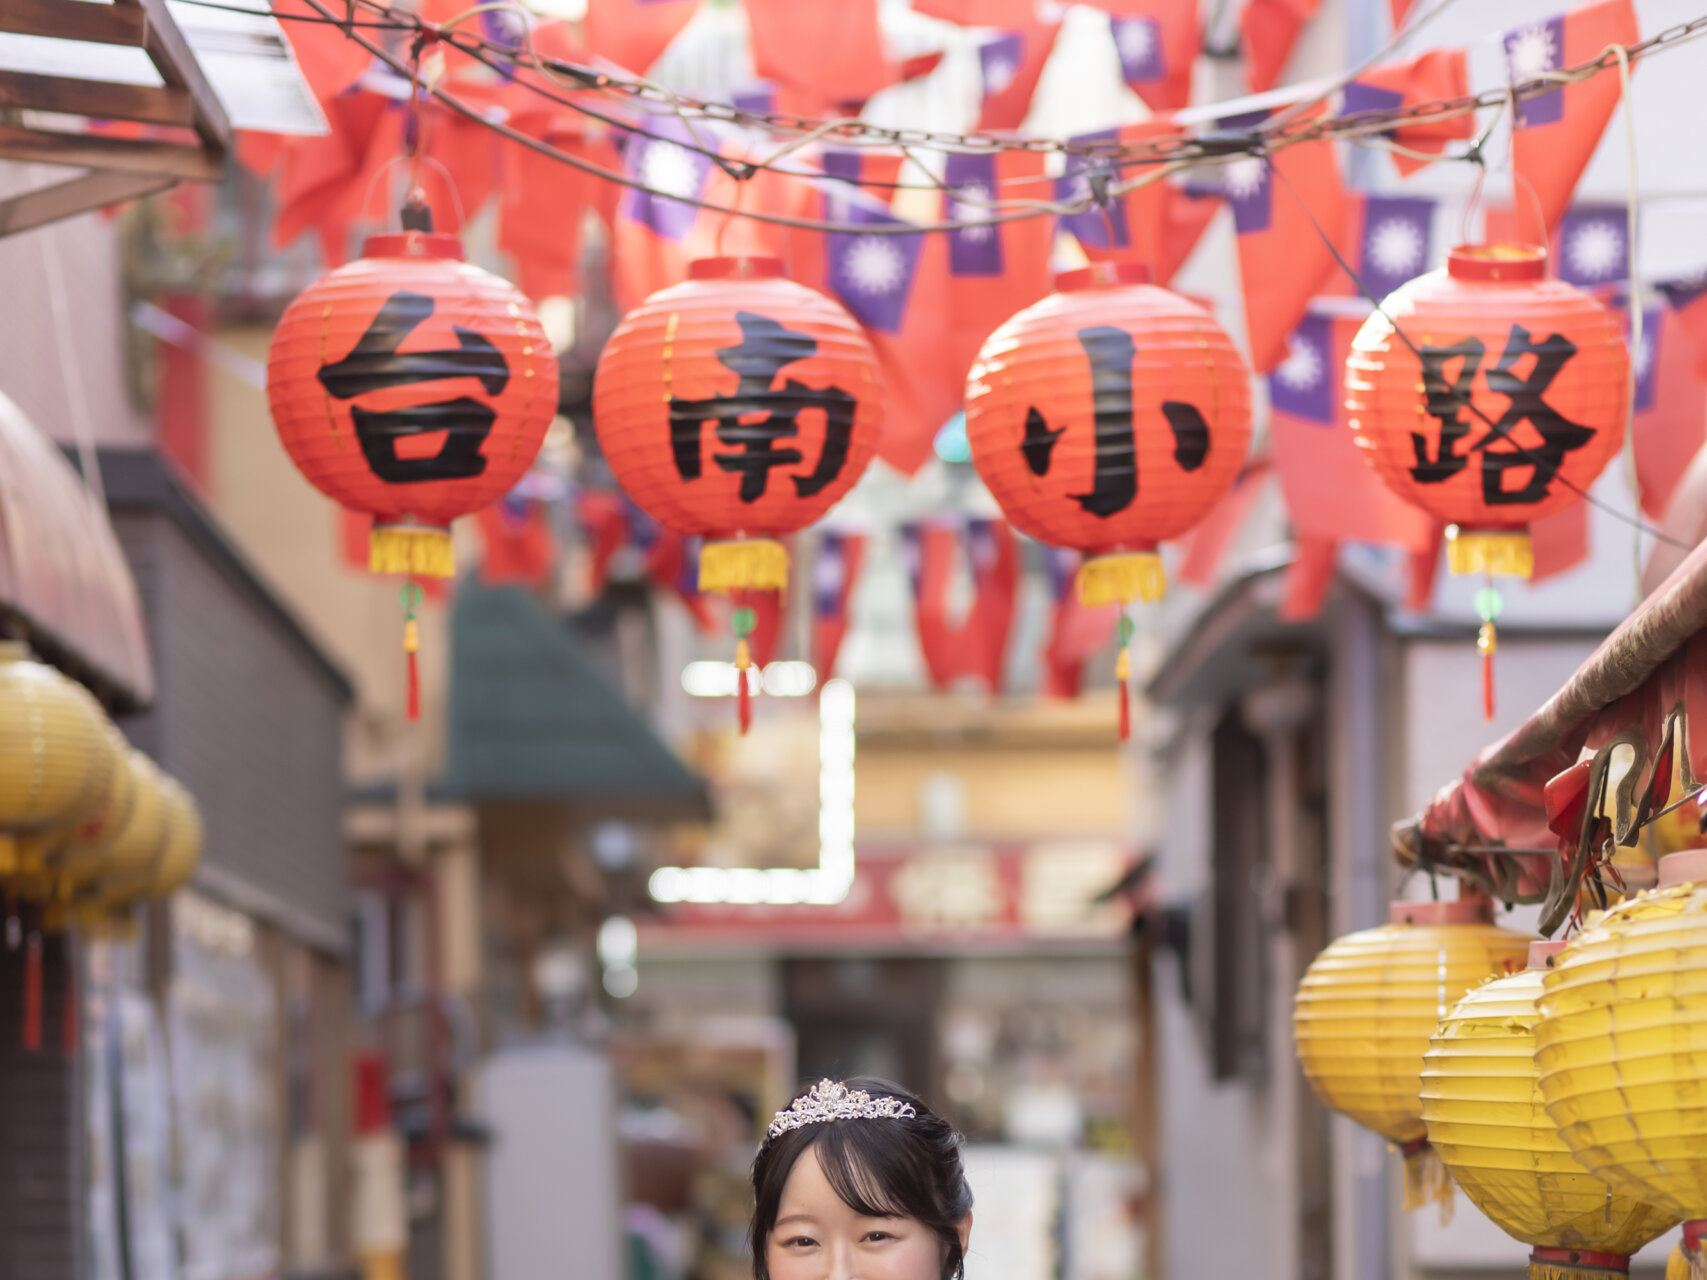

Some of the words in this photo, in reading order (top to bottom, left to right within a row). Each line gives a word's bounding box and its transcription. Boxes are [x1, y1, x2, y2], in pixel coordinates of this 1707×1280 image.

[317, 291, 510, 484] 台
[668, 311, 857, 503] 南
[1020, 325, 1210, 517] 小
[1408, 325, 1598, 504] 路
